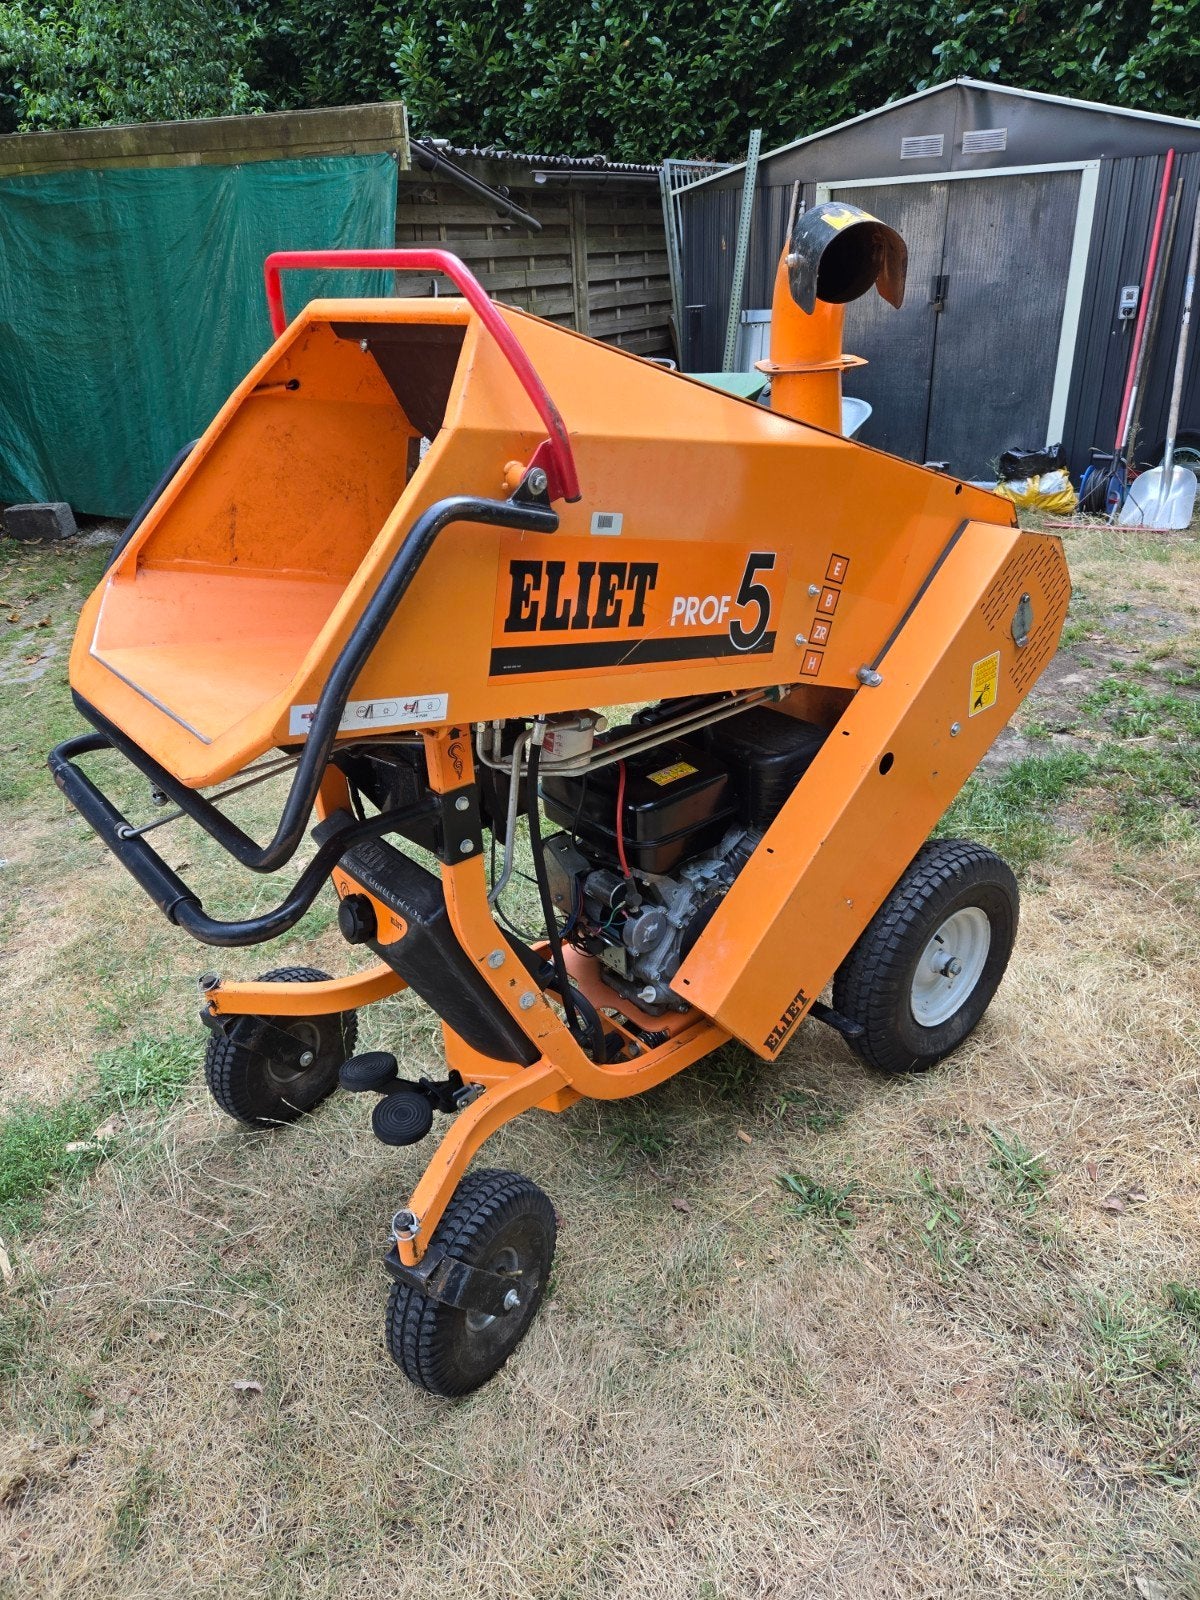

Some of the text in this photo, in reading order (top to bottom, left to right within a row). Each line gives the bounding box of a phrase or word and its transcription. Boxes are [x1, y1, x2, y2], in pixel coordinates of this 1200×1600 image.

[833, 561, 842, 576] E
[503, 551, 777, 651] ELIET PROF 5
[824, 593, 834, 608] B
[812, 625, 828, 641] ZR
[806, 657, 817, 671] H
[763, 988, 808, 1052] ELIET
